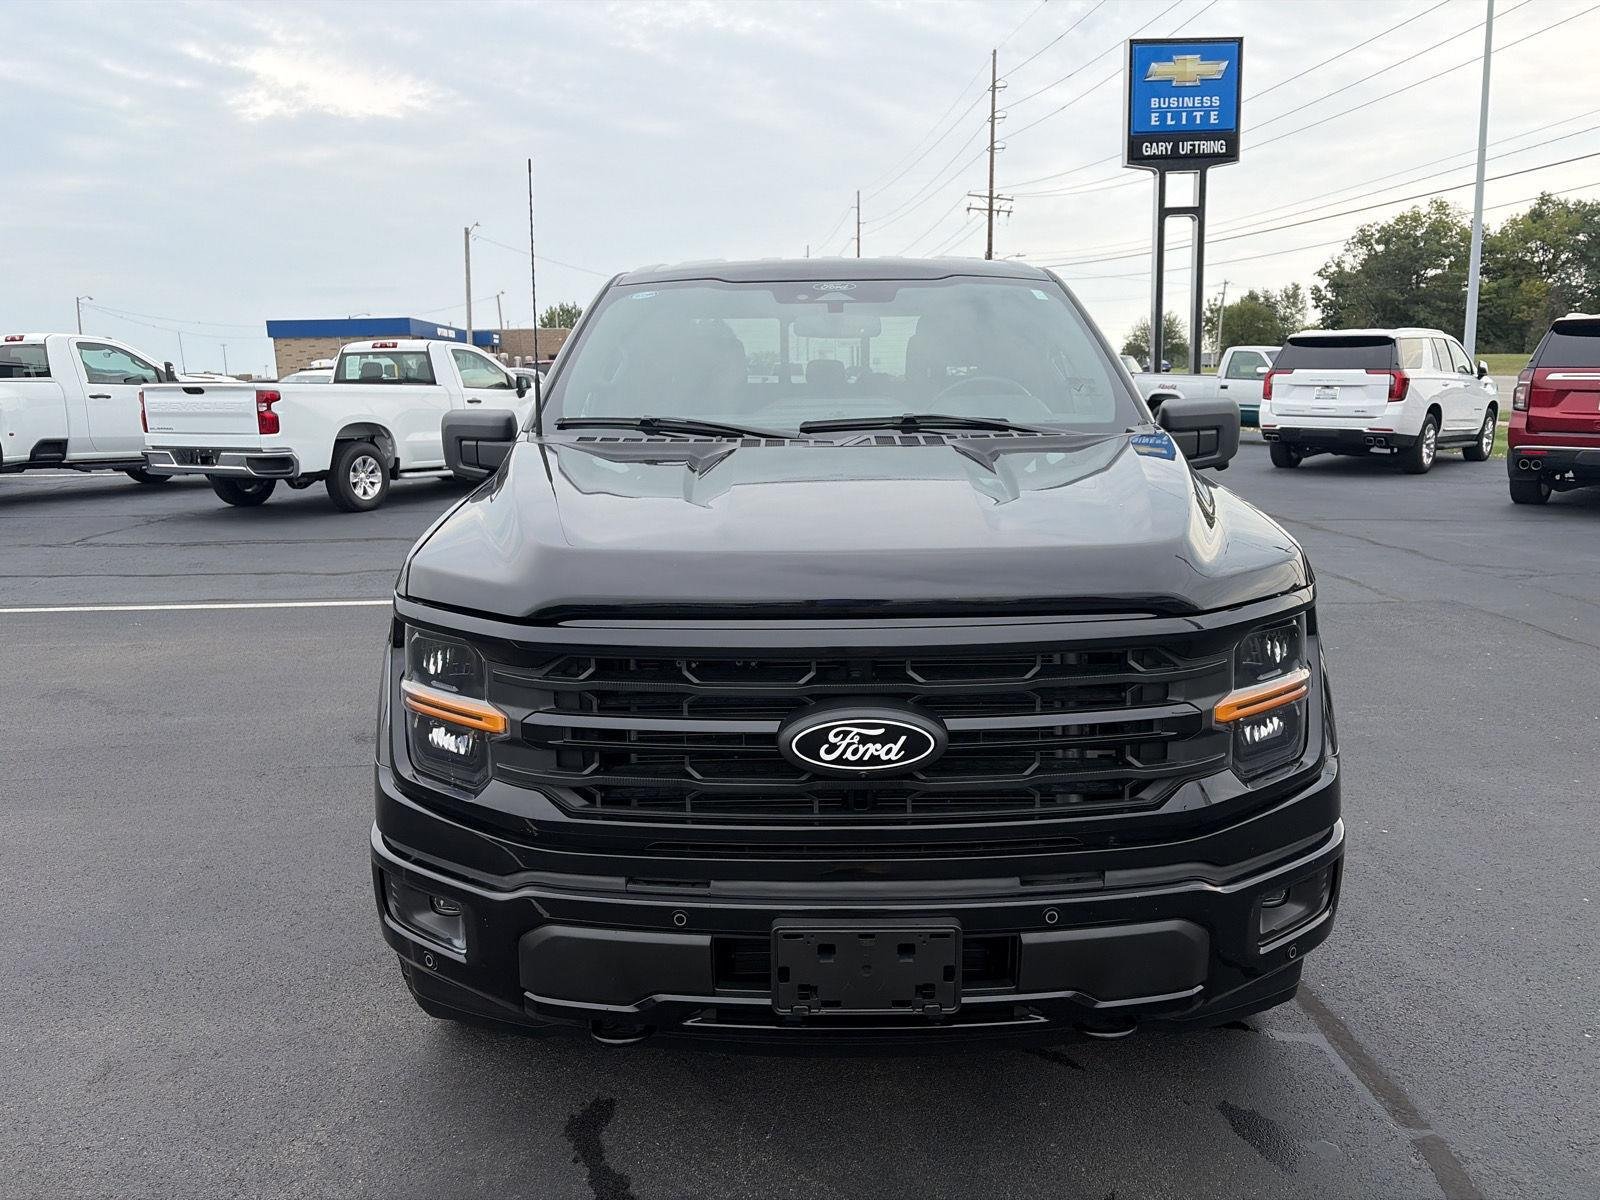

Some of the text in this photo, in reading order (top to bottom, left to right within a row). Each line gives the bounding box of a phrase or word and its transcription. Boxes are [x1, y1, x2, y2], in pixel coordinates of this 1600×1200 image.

[1150, 96, 1220, 108] BUSINESS
[1150, 111, 1219, 125] ELITE
[1142, 140, 1226, 156] GARY UFTRING
[819, 726, 907, 761] Ford
